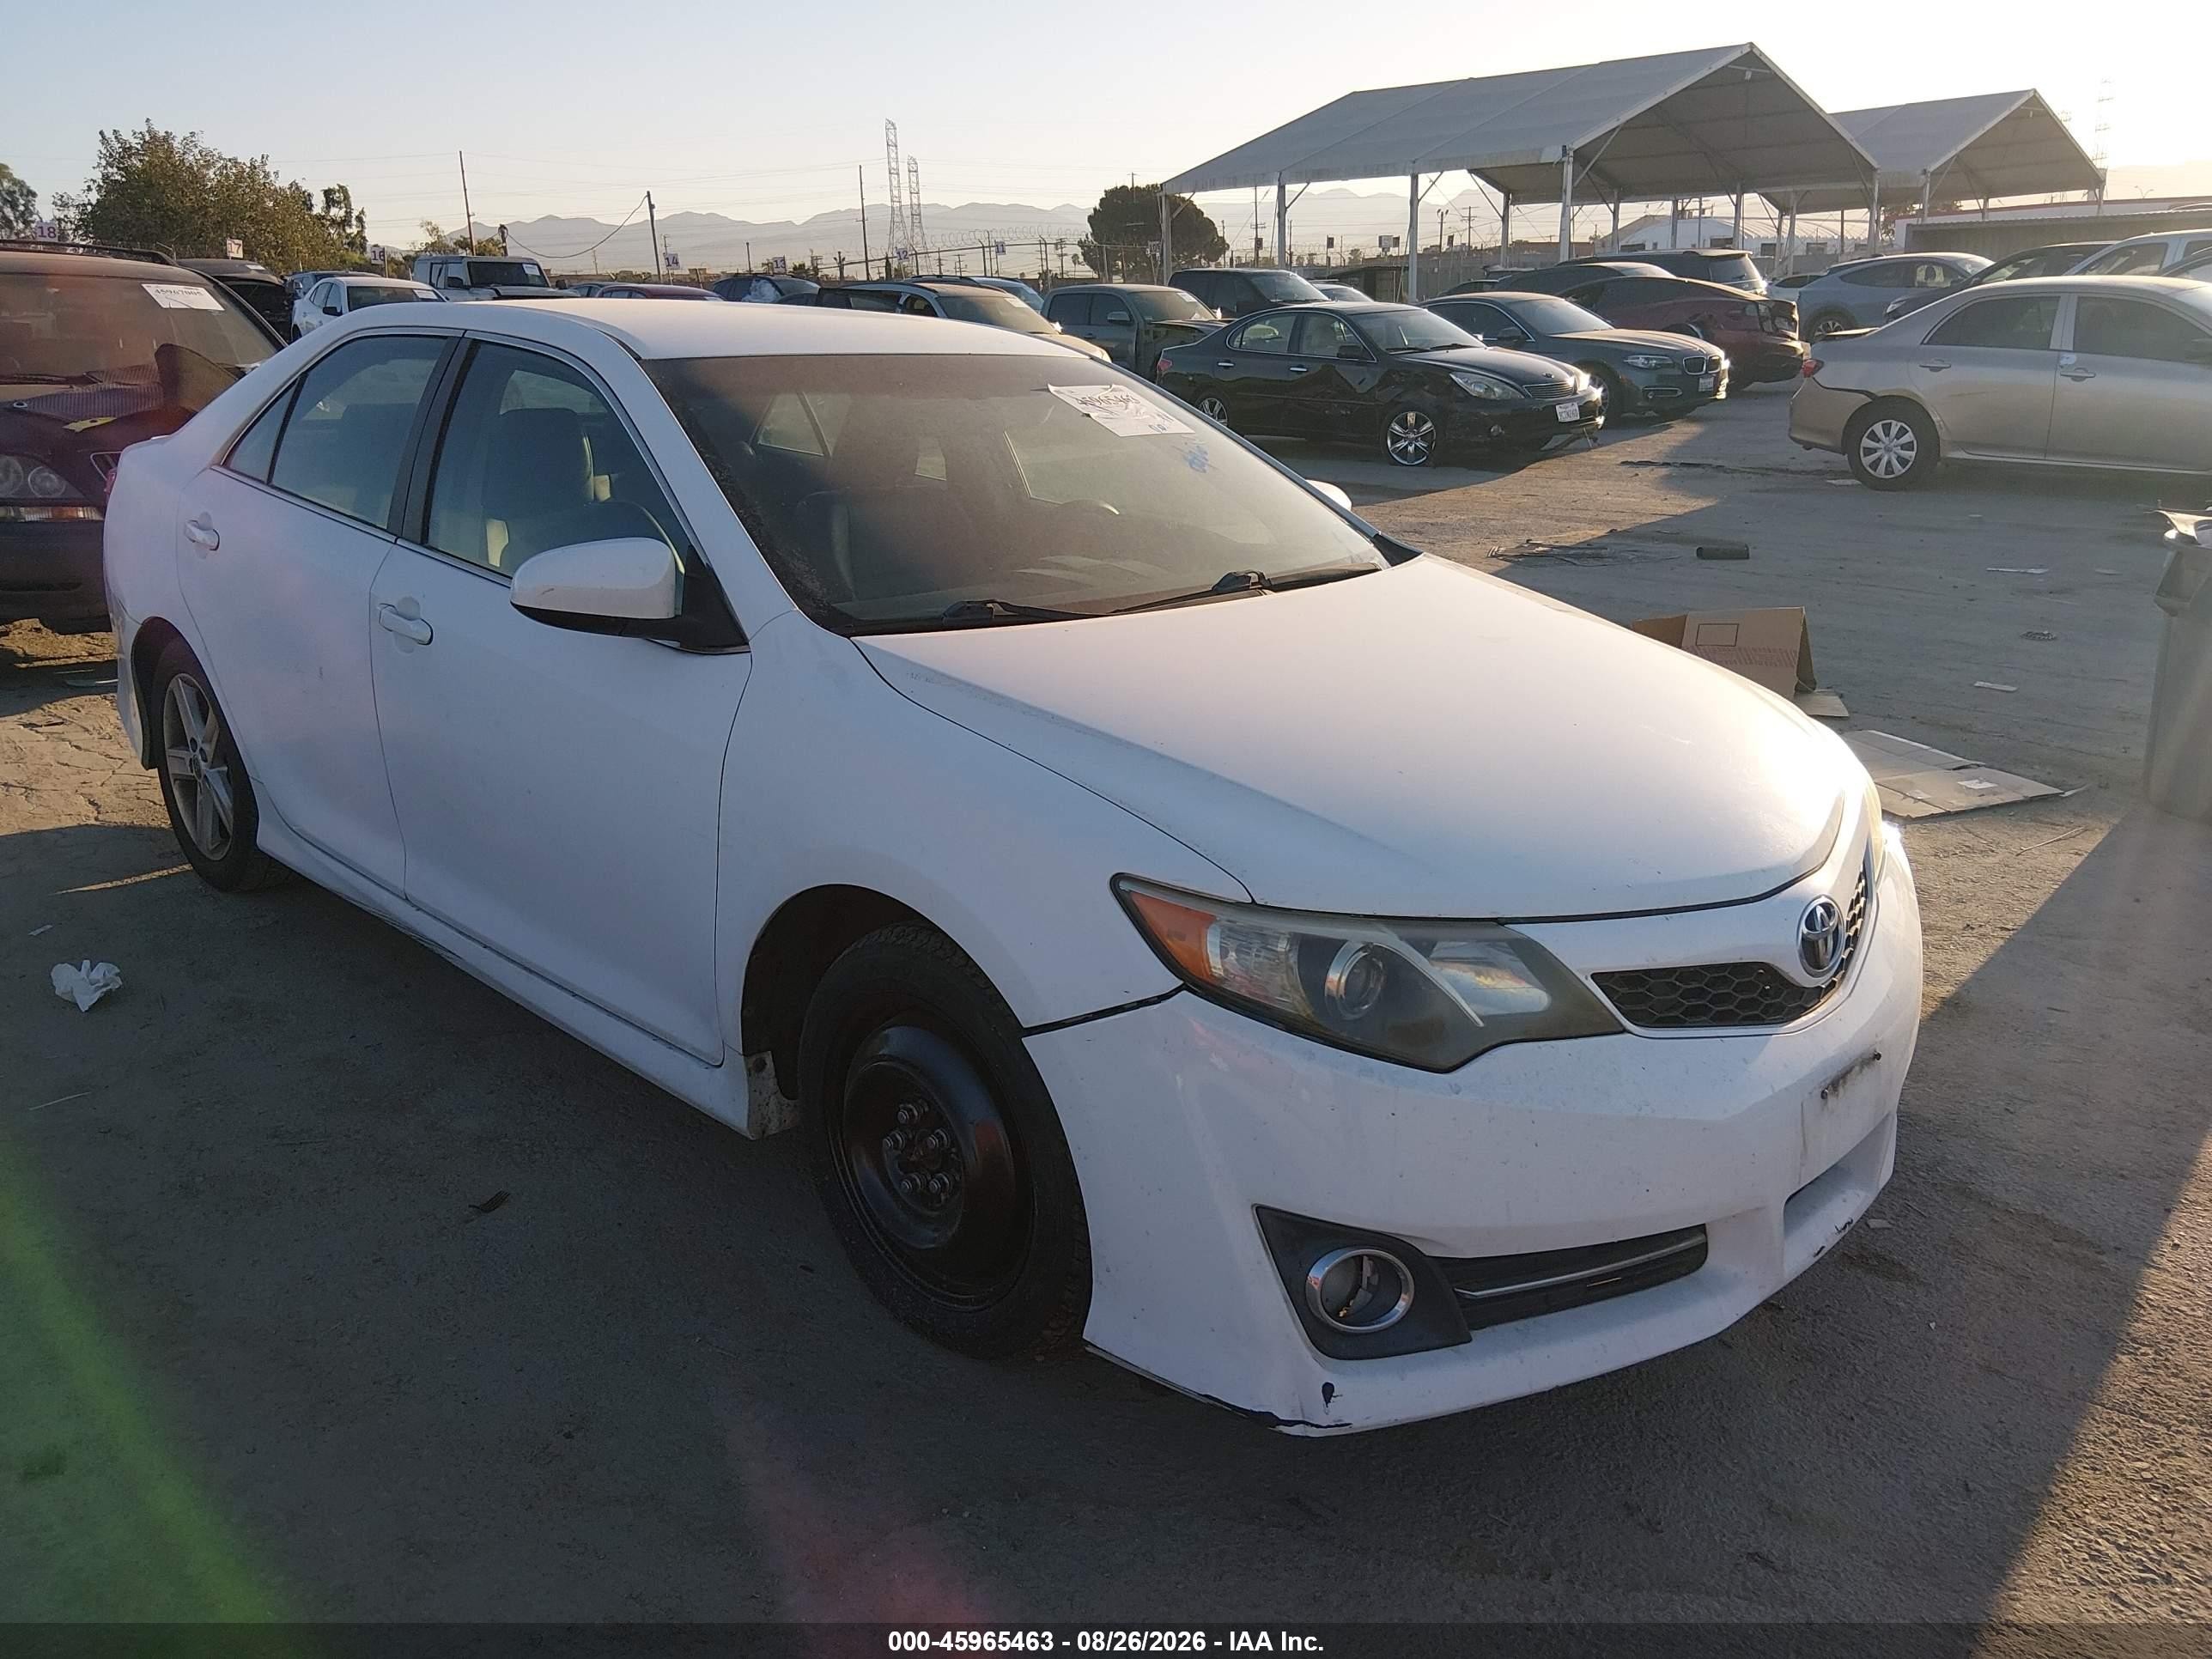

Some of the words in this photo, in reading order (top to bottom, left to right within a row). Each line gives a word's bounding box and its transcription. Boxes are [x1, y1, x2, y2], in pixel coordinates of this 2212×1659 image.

[37, 226, 57, 239] 18
[228, 242, 241, 255] 17
[896, 250, 909, 261] 12
[665, 256, 679, 267] 14
[773, 258, 786, 269] 13
[1078, 393, 1141, 405] 45965463
